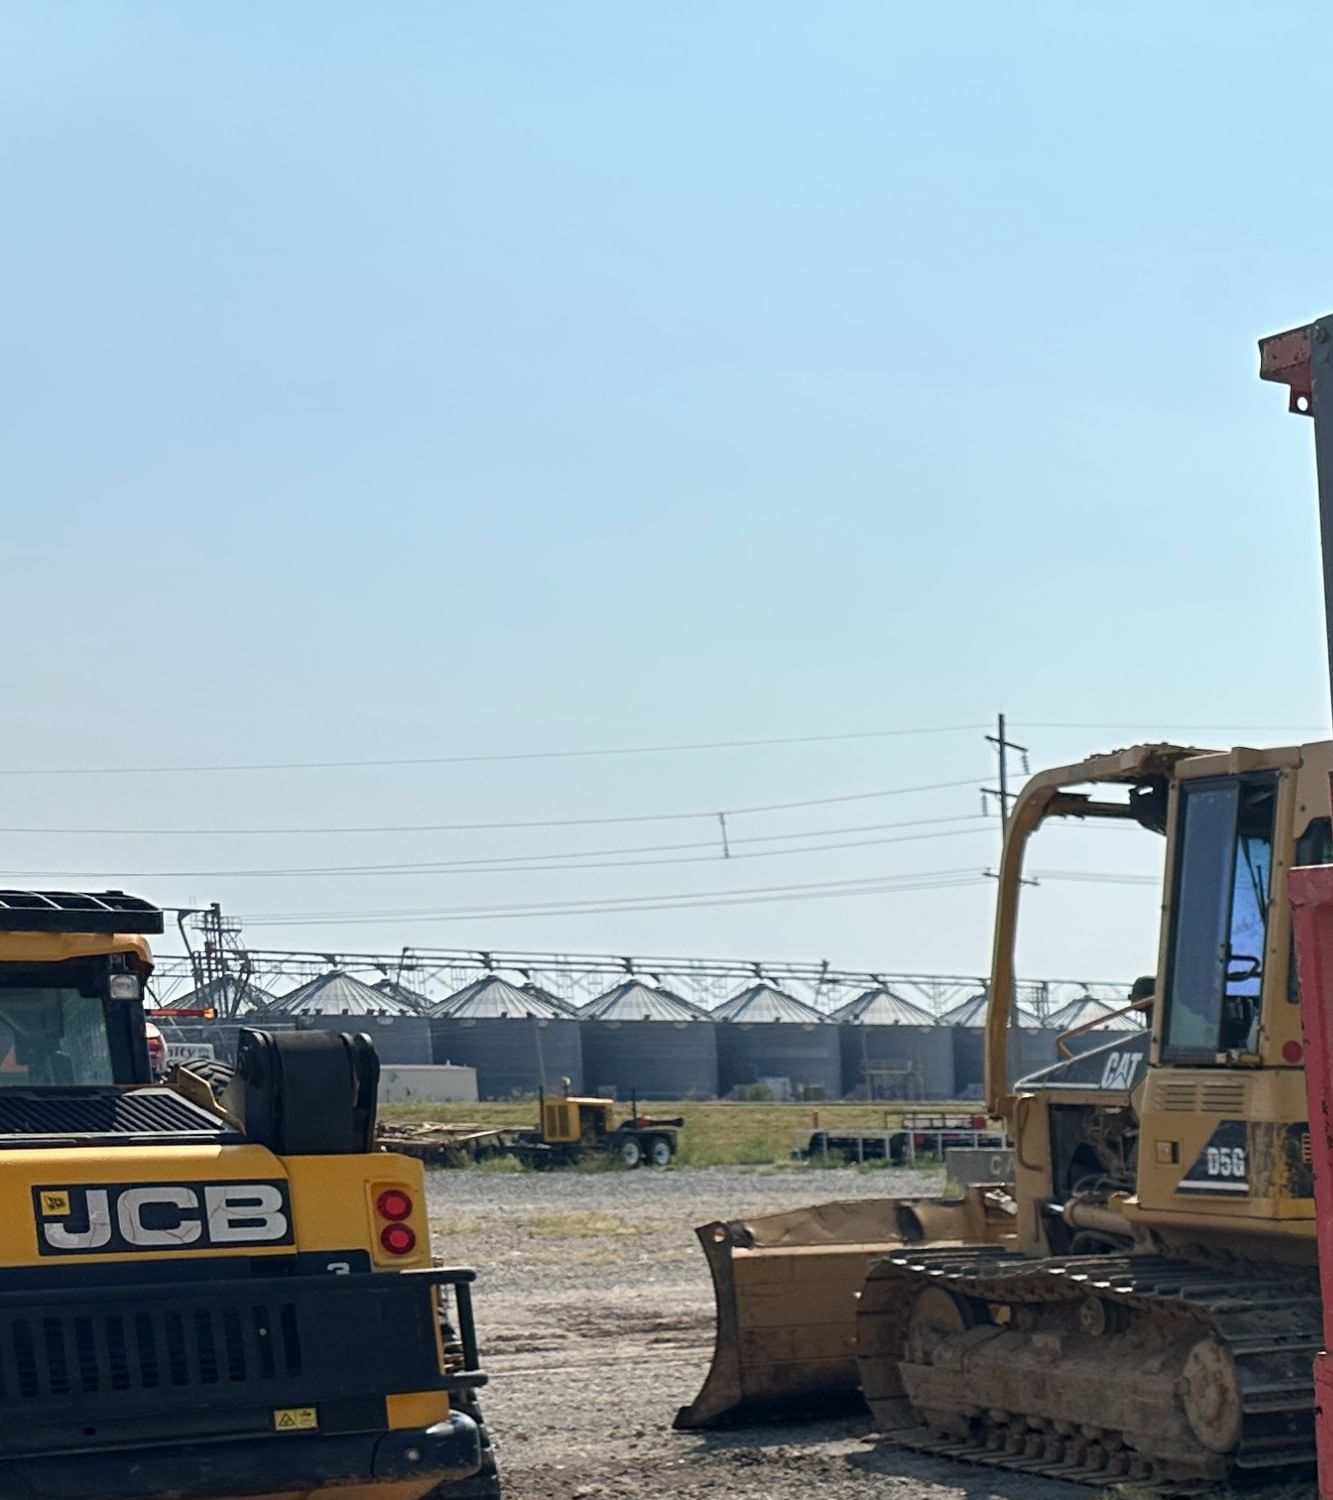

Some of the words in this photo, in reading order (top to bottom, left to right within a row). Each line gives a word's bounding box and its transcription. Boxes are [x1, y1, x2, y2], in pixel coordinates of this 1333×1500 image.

[1100, 1052, 1143, 1089] CAT
[1207, 1147, 1246, 1177] D5G
[44, 1185, 288, 1249] JCB
